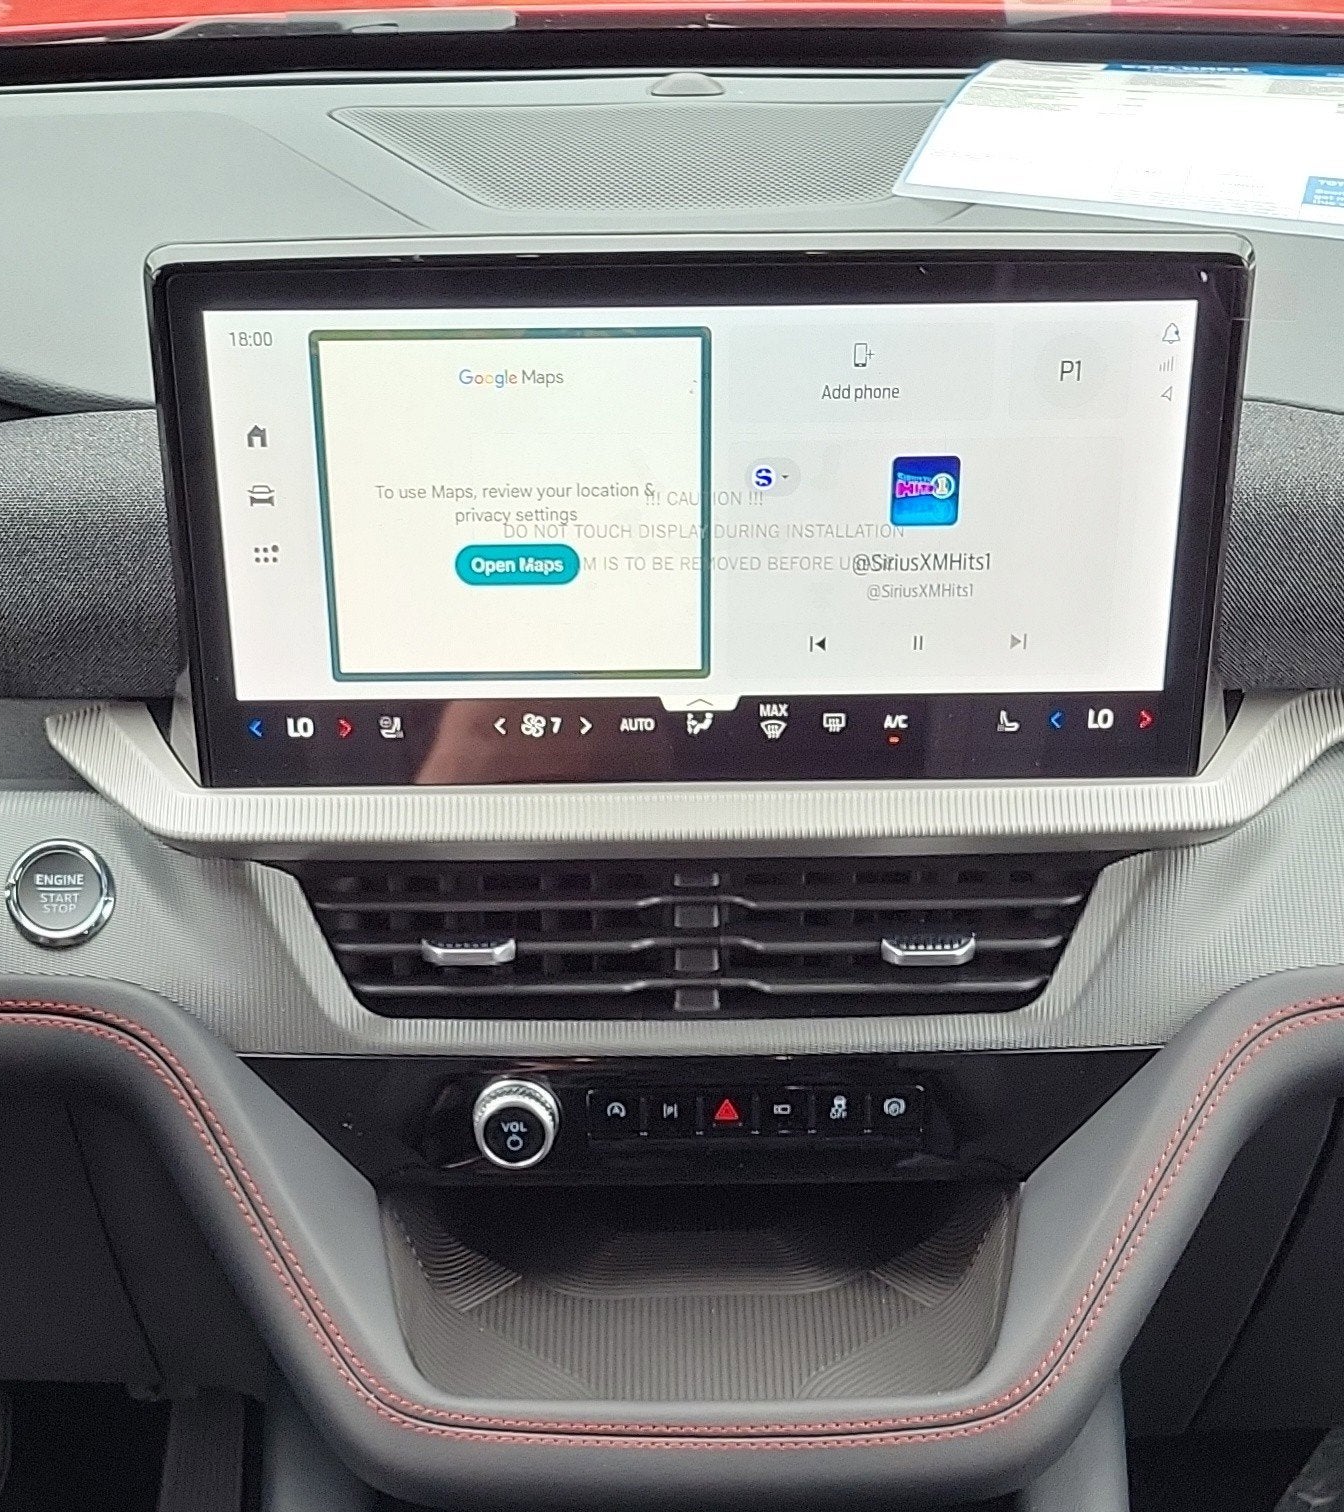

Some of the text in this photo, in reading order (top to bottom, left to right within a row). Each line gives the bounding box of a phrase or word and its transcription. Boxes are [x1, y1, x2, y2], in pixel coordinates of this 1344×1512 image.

[228, 331, 274, 348] 18:00
[459, 369, 564, 388] Google Maps
[1059, 361, 1083, 382] P1
[821, 384, 900, 402] Add phone
[375, 482, 655, 501] To use Maps, review your location &
[667, 491, 743, 506] CAUION
[748, 491, 763, 506] !!!
[455, 507, 578, 525] privacy settings
[504, 524, 904, 539] DO NOT TOUCH DISPLAY DURING INSTALLATION
[471, 557, 516, 577] Open
[519, 557, 564, 576] Maps
[604, 556, 619, 571] IS
[625, 556, 646, 571] TO
[653, 556, 674, 571] BE
[768, 556, 833, 571] BEFORE
[853, 552, 991, 575] @SiriusXMHits1
[866, 583, 974, 601] @SiriusXMHits1
[759, 703, 788, 717] MAX
[286, 716, 315, 738] LO
[551, 717, 562, 734] 7
[619, 717, 655, 732] AUTO
[883, 715, 909, 729] A/C
[1087, 709, 1115, 729] LO
[35, 873, 84, 886] ENGINE
[40, 892, 79, 903] START
[42, 902, 77, 913] STOP
[501, 1121, 528, 1134] VOL
